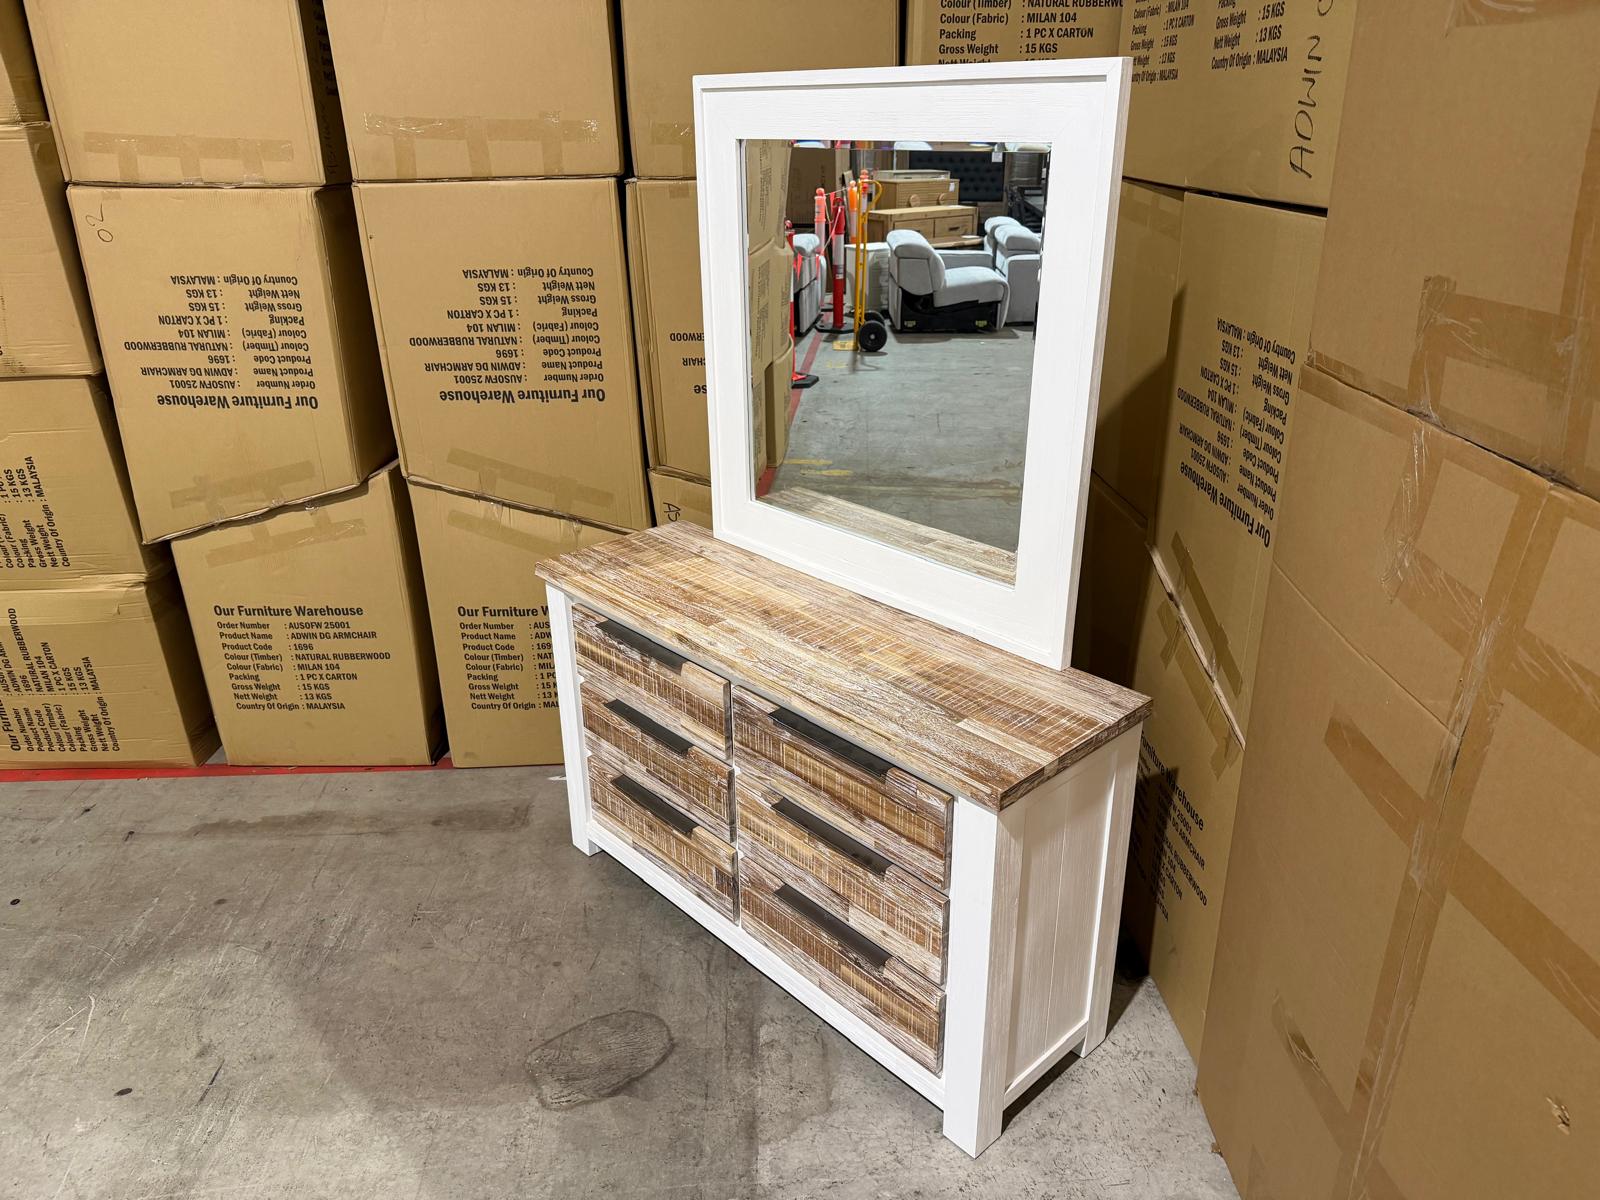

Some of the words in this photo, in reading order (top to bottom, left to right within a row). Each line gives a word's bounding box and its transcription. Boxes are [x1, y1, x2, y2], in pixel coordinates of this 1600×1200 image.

[939, 12, 971, 24] Colour
[972, 12, 1009, 26] (Fabric)
[1026, 12, 1057, 23] MILAN
[1059, 11, 1077, 23] 104
[1215, 16, 1229, 31] Gross
[1229, 10, 1247, 29] Weight
[1261, 2, 1271, 20] 15
[1270, 0, 1285, 18] KGS
[939, 28, 977, 41] Packing
[1033, 28, 1047, 39] PC
[1056, 27, 1094, 38] CARTON
[1213, 35, 1224, 50] Nett
[1223, 31, 1241, 50] Weight
[1258, 26, 1268, 43] 13
[1267, 23, 1282, 42] KGS
[938, 43, 965, 55] Gross
[966, 43, 999, 57] Weight
[1025, 41, 1037, 54] 15
[1038, 42, 1058, 53] KGS
[1211, 54, 1229, 71] Country
[1229, 52, 1236, 68] Of
[1235, 51, 1252, 70] Origin
[1256, 46, 1288, 66] MALAYSIA
[169, 275, 216, 285] MALAYSIA
[223, 273, 250, 285] Origin
[251, 275, 262, 286] Of
[263, 273, 298, 285] Country
[477, 282, 497, 293] KGS
[498, 282, 510, 292] 13
[542, 280, 575, 292] Weight
[575, 281, 595, 291] Nett
[447, 309, 484, 319] CARTON
[485, 309, 492, 319] X
[493, 309, 506, 319] PC
[507, 309, 514, 319] 1
[561, 306, 598, 318] Packing
[177, 329, 195, 338] 104
[196, 329, 226, 339] MILAN
[241, 327, 277, 339] (Fabric)
[278, 329, 307, 339] Colour
[1217, 317, 1243, 341] MALAYSIA
[1246, 330, 1263, 350] Origin
[124, 341, 187, 351] RUBBERWOOD
[187, 342, 229, 351] NATURAL
[242, 340, 279, 352] (Timber)
[280, 342, 309, 352] Colour
[1263, 338, 1271, 354] Of
[495, 349, 519, 359] 1696
[543, 348, 566, 358] Code
[567, 347, 602, 358] Product
[1271, 339, 1295, 365] Country
[424, 362, 474, 372] ARMCHAIR
[475, 362, 489, 371] DG
[490, 362, 521, 371] ADWIN
[541, 361, 567, 370] Name
[568, 360, 603, 370] Product
[140, 366, 187, 376] ARMCHAIR
[188, 367, 202, 376] DG
[203, 367, 233, 377] ADWIN
[253, 368, 278, 377] Name
[278, 368, 313, 377] Product
[453, 375, 483, 384] 25001
[484, 374, 523, 384] AUSOFW
[544, 373, 578, 383] Number
[579, 373, 604, 383] Order
[168, 379, 198, 389] 25001
[199, 380, 235, 389] AUSOFW
[256, 380, 290, 390] Number
[291, 380, 315, 390] Order
[439, 390, 516, 404] Warehouse
[517, 389, 579, 403] Furniture
[582, 388, 606, 402] Our
[156, 394, 230, 409] Warehouse
[231, 395, 292, 410] Furniture
[294, 396, 318, 410] Our
[1216, 430, 1230, 449] 1696
[1242, 448, 1257, 468] Code
[1256, 457, 1280, 483] Product
[3, 469, 17, 486] KGS
[15, 468, 29, 485] KGS
[23, 456, 45, 497] MALAYSIA
[1181, 461, 1217, 507] Warehouse
[10, 487, 21, 498] 15
[22, 487, 33, 497] 13
[41, 504, 56, 527] Origin
[1219, 491, 1254, 536] Furniture
[22, 519, 39, 546] Weight
[36, 524, 52, 550] Weight
[48, 528, 59, 537] Of
[1255, 520, 1271, 548] Our
[34, 546, 47, 567] Gross
[54, 538, 70, 567] Country
[46, 551, 59, 567] Nett
[213, 605, 235, 617] Our
[236, 605, 293, 617] Furniture
[293, 604, 363, 616] Warehouse
[457, 606, 480, 618] Our
[482, 605, 539, 617] Furniture
[216, 622, 238, 630] Order
[239, 621, 270, 630] Number
[288, 621, 323, 629] AUSOFW
[324, 621, 351, 629] 25001
[5, 609, 32, 660] RUBBERWOOD
[219, 632, 250, 640] Product
[250, 632, 273, 640] Name
[291, 631, 318, 640] ADWIN
[319, 632, 332, 640] DG
[333, 631, 377, 640] ARMCHAIR
[224, 652, 249, 660] Colour
[250, 652, 283, 662] (Timber)
[295, 652, 332, 660] NATURAL
[332, 652, 391, 660] RUBBERWOOD
[464, 653, 490, 661] Colour
[491, 652, 524, 662] (Timber)
[25, 661, 44, 692] NATURAL
[81, 656, 100, 691] MALAYSIA
[229, 673, 260, 682] Packing
[306, 673, 318, 681] PC
[325, 673, 358, 681] CARTON
[19, 675, 33, 692] 1696
[253, 683, 281, 692] Weight
[302, 682, 313, 691] 15
[313, 683, 330, 691] KGS
[468, 683, 491, 691] Gross
[491, 683, 519, 692] Weight
[540, 681, 551, 689] 15
[96, 697, 109, 717] Origin
[236, 702, 265, 711] Country
[266, 702, 275, 710] Of
[276, 702, 299, 711] Origin
[471, 702, 501, 711] Country
[512, 701, 535, 710] Origin
[34, 709, 46, 726] Code
[41, 703, 60, 730] (Timber)
[101, 717, 112, 726] Of
[39, 726, 56, 751] Product
[53, 730, 66, 751] Colour
[107, 726, 121, 751] Country
